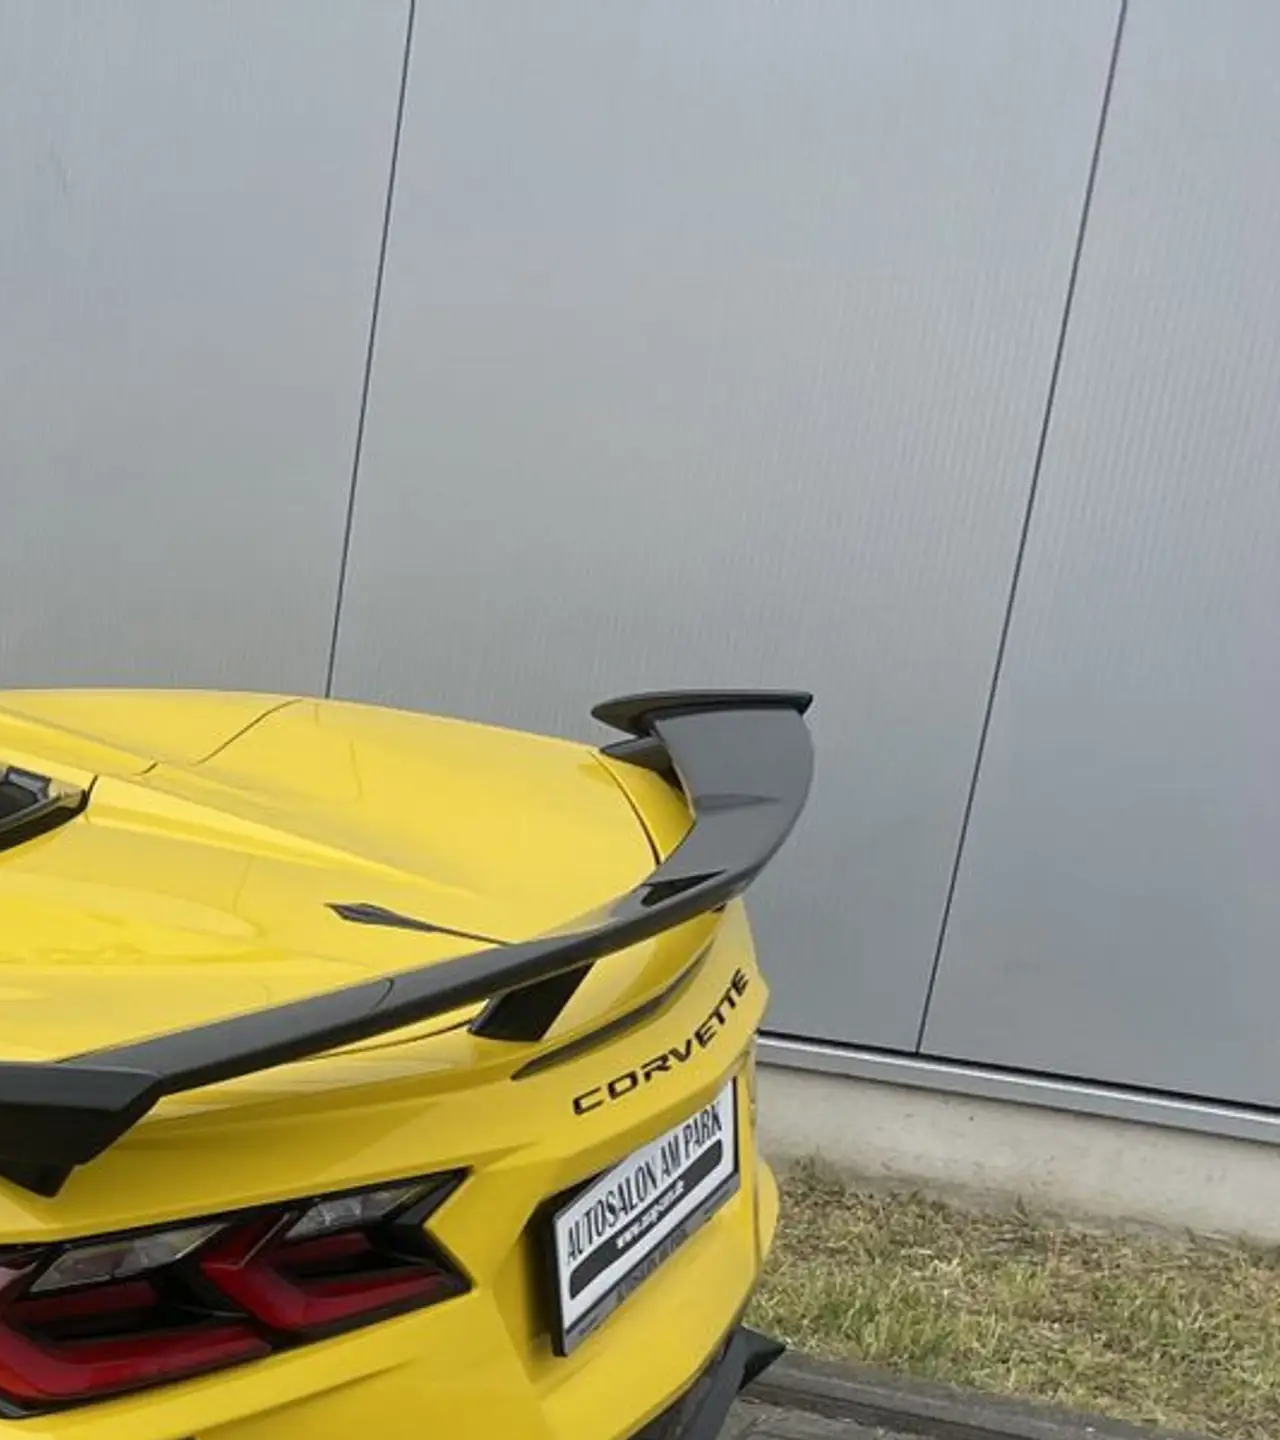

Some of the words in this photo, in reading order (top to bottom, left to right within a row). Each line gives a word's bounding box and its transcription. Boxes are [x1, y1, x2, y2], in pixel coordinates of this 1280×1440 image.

[572, 967, 750, 1115] CORVETTE
[566, 1158, 658, 1264] AUTOSALON
[659, 1141, 681, 1182] AM
[683, 1101, 723, 1160] PARK
